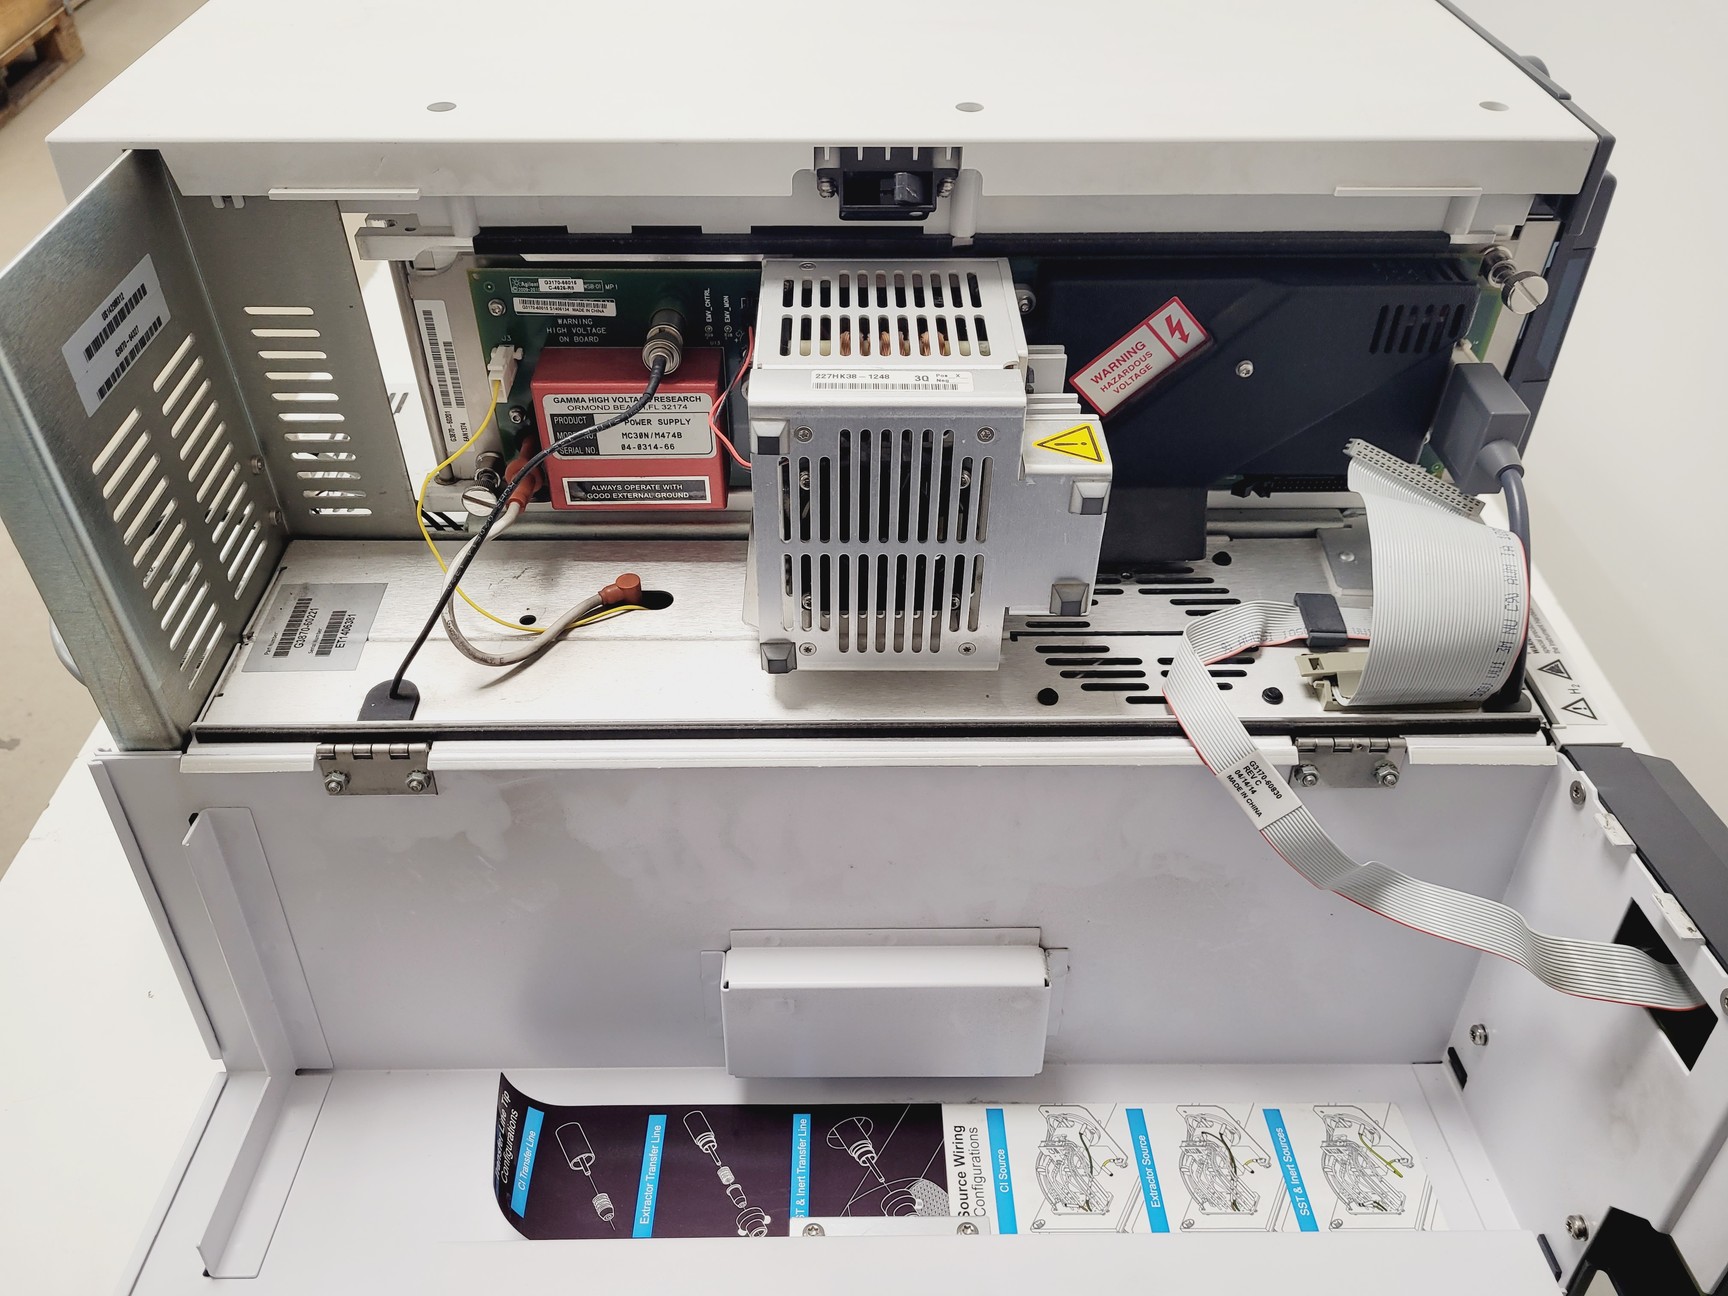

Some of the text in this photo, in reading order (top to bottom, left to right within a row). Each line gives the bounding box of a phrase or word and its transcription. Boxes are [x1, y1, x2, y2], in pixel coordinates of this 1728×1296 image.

[1090, 341, 1146, 384] WARNING
[1100, 351, 1153, 392] HAZARDOUS
[1113, 364, 1153, 394] VOLTAGE
[1234, 770, 1257, 795] 04/14/14
[1243, 765, 1258, 780] REV
[1250, 760, 1282, 799] G3170-60830
[1227, 775, 1243, 792] MADE
[1246, 798, 1262, 817] CHINA
[501, 1090, 511, 1107] Tip
[499, 1109, 507, 1135] Line
[798, 1118, 807, 1136] Line
[501, 1109, 519, 1184] Configurations
[518, 1130, 536, 1190] CI Transfer Line
[797, 1139, 806, 1174] Transfer
[1276, 1128, 1292, 1162] Sources
[640, 1125, 662, 1224] Extractor Transfer Line
[796, 1176, 806, 1196] Inert
[952, 1125, 970, 1216] Source Wiring
[968, 1127, 986, 1216] Configurations
[997, 1149, 1010, 1193] CI Source
[1139, 1135, 1160, 1208] Extractor Source
[1286, 1164, 1300, 1184] Inert
[796, 1209, 805, 1218] ST
[1296, 1196, 1310, 1216] SST
